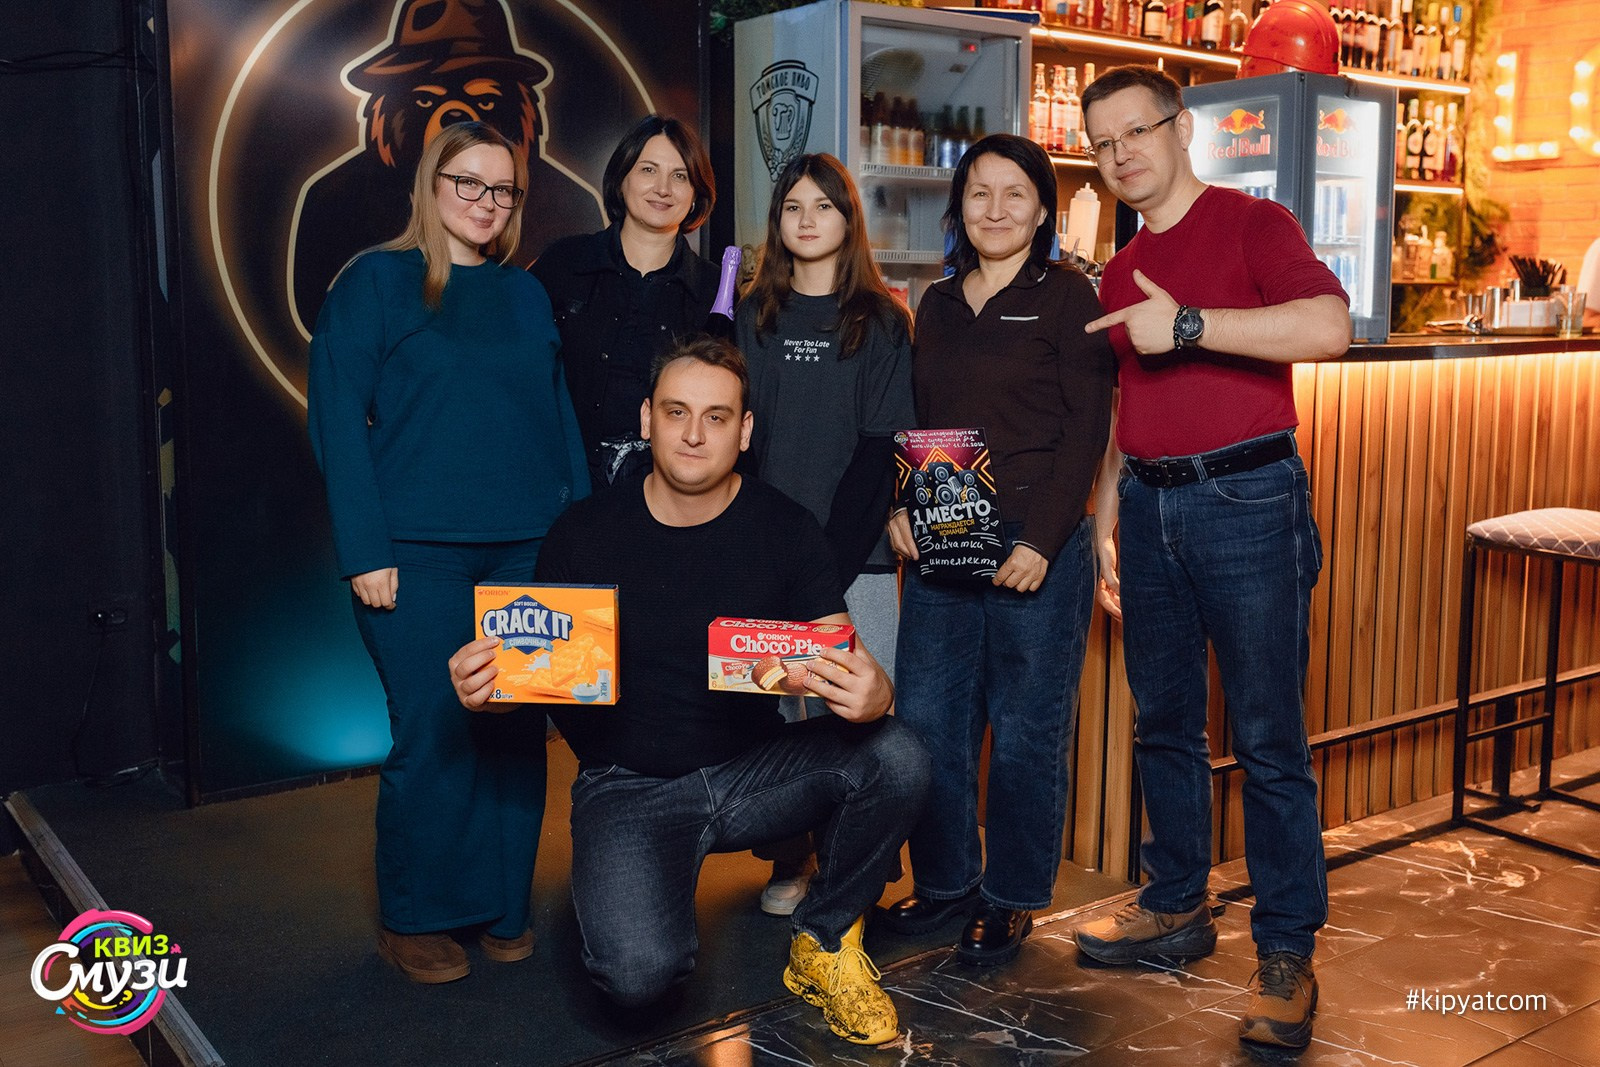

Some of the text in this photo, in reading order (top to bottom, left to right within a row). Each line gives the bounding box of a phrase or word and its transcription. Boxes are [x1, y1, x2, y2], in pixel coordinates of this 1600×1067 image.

[756, 71, 810, 99] ТОМСКОЕ ПИВО
[1207, 133, 1271, 160] Red Bull
[805, 346, 818, 354] Fun
[814, 340, 830, 348] Late
[912, 499, 991, 526] 1 МЕСТО
[930, 518, 975, 530] НАГРАЖДАЕТСЯ
[938, 526, 969, 536] КОМАНДА
[917, 535, 984, 554] Зайчатки
[929, 556, 997, 568] интеллекта
[483, 607, 572, 641] CRACK IT
[765, 633, 794, 641] ORION
[600, 682, 608, 697] MILK
